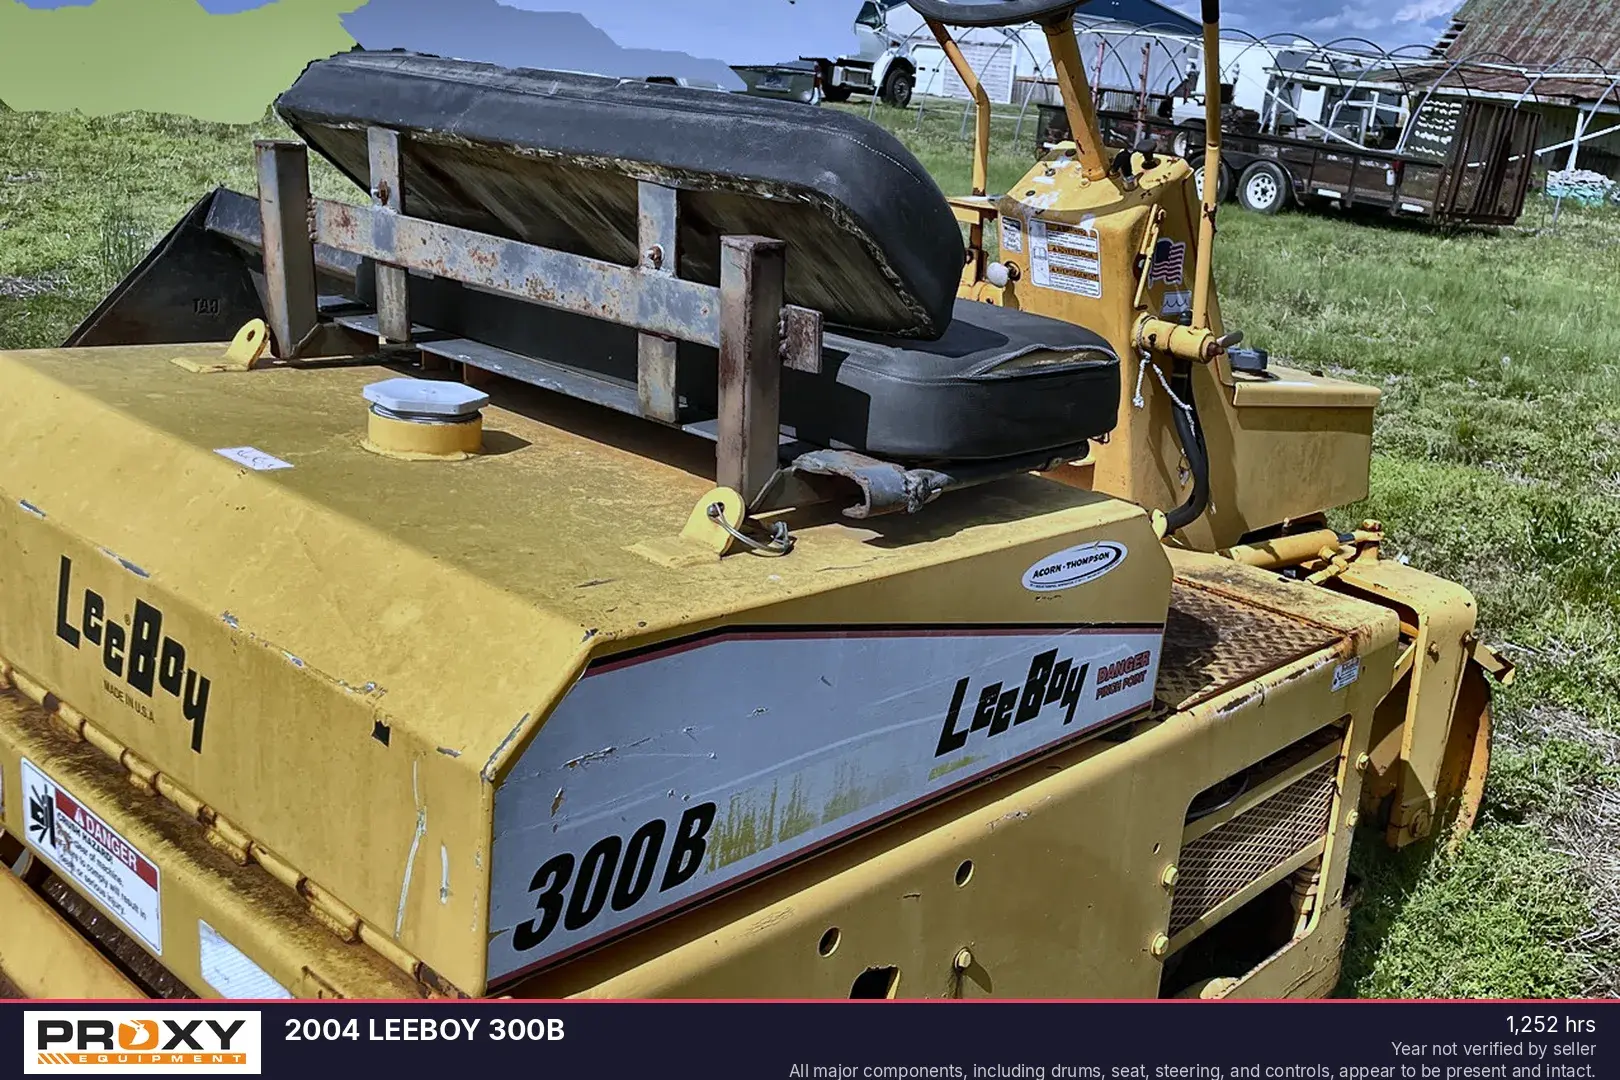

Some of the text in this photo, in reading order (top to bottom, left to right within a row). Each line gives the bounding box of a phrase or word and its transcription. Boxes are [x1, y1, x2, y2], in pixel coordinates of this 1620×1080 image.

[56, 554, 211, 754] LeeBoy
[1096, 650, 1151, 685] DANGER
[104, 680, 124, 704] MADE
[125, 695, 134, 709] IN
[934, 647, 1091, 758] LeeBoy
[1122, 669, 1148, 690] POINT
[86, 814, 138, 872] DANGER
